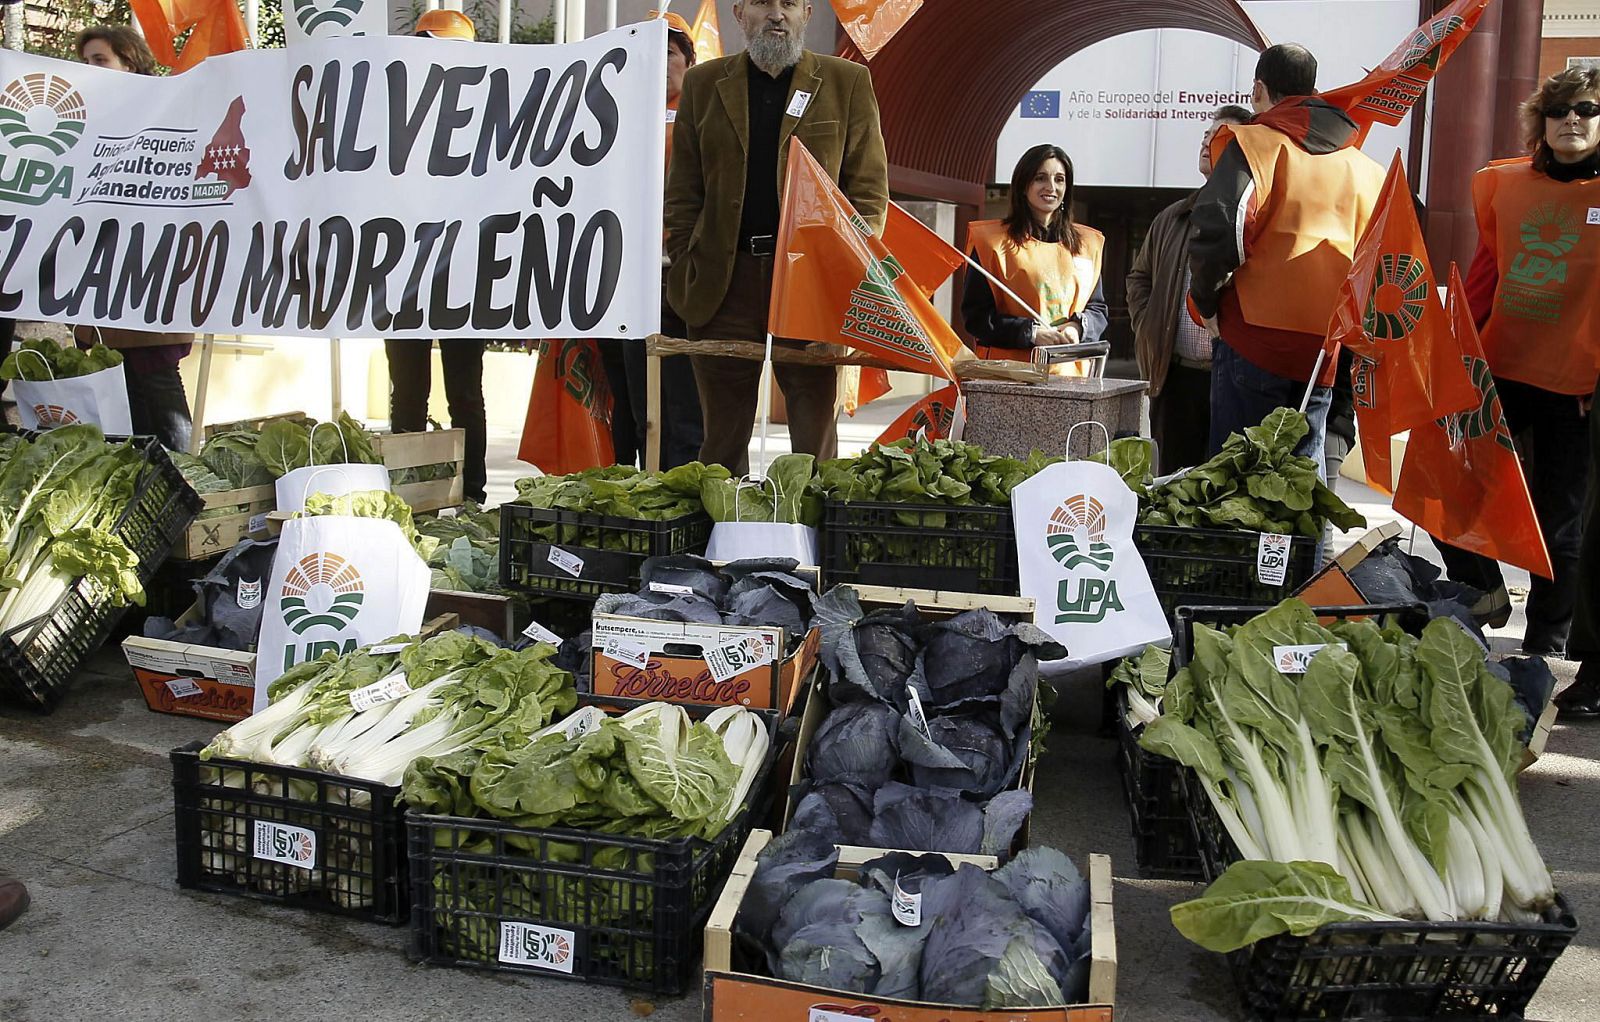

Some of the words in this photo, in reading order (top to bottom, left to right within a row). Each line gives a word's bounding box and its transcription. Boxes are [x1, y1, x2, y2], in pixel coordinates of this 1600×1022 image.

[1069, 90, 1093, 104] Año
[1098, 91, 1149, 108] Europeo
[1155, 90, 1173, 104] del
[1364, 95, 1411, 113] anader
[284, 48, 628, 180] SALVEMOS
[1068, 111, 1074, 120] y
[1077, 109, 1089, 118] de
[1092, 109, 1100, 118] la
[1105, 109, 1168, 119] Solidaridad
[134, 135, 195, 155] Pequeños
[87, 156, 192, 180] Agricultores
[78, 186, 90, 202] y
[90, 180, 189, 200] Ganaderos
[193, 182, 228, 198] MADRID
[38, 215, 228, 327] CAMPO
[232, 177, 623, 333] MADRILEÑO
[1506, 253, 1568, 285] UPA
[850, 296, 878, 311] Unión
[880, 306, 892, 315] de
[843, 318, 853, 329] y
[847, 306, 917, 336] Agriculto
[1260, 555, 1284, 568] UPA
[1055, 578, 1125, 624] UPA
[721, 645, 744, 671] UPA
[273, 827, 287, 857] UPA
[523, 927, 540, 960] UPA
